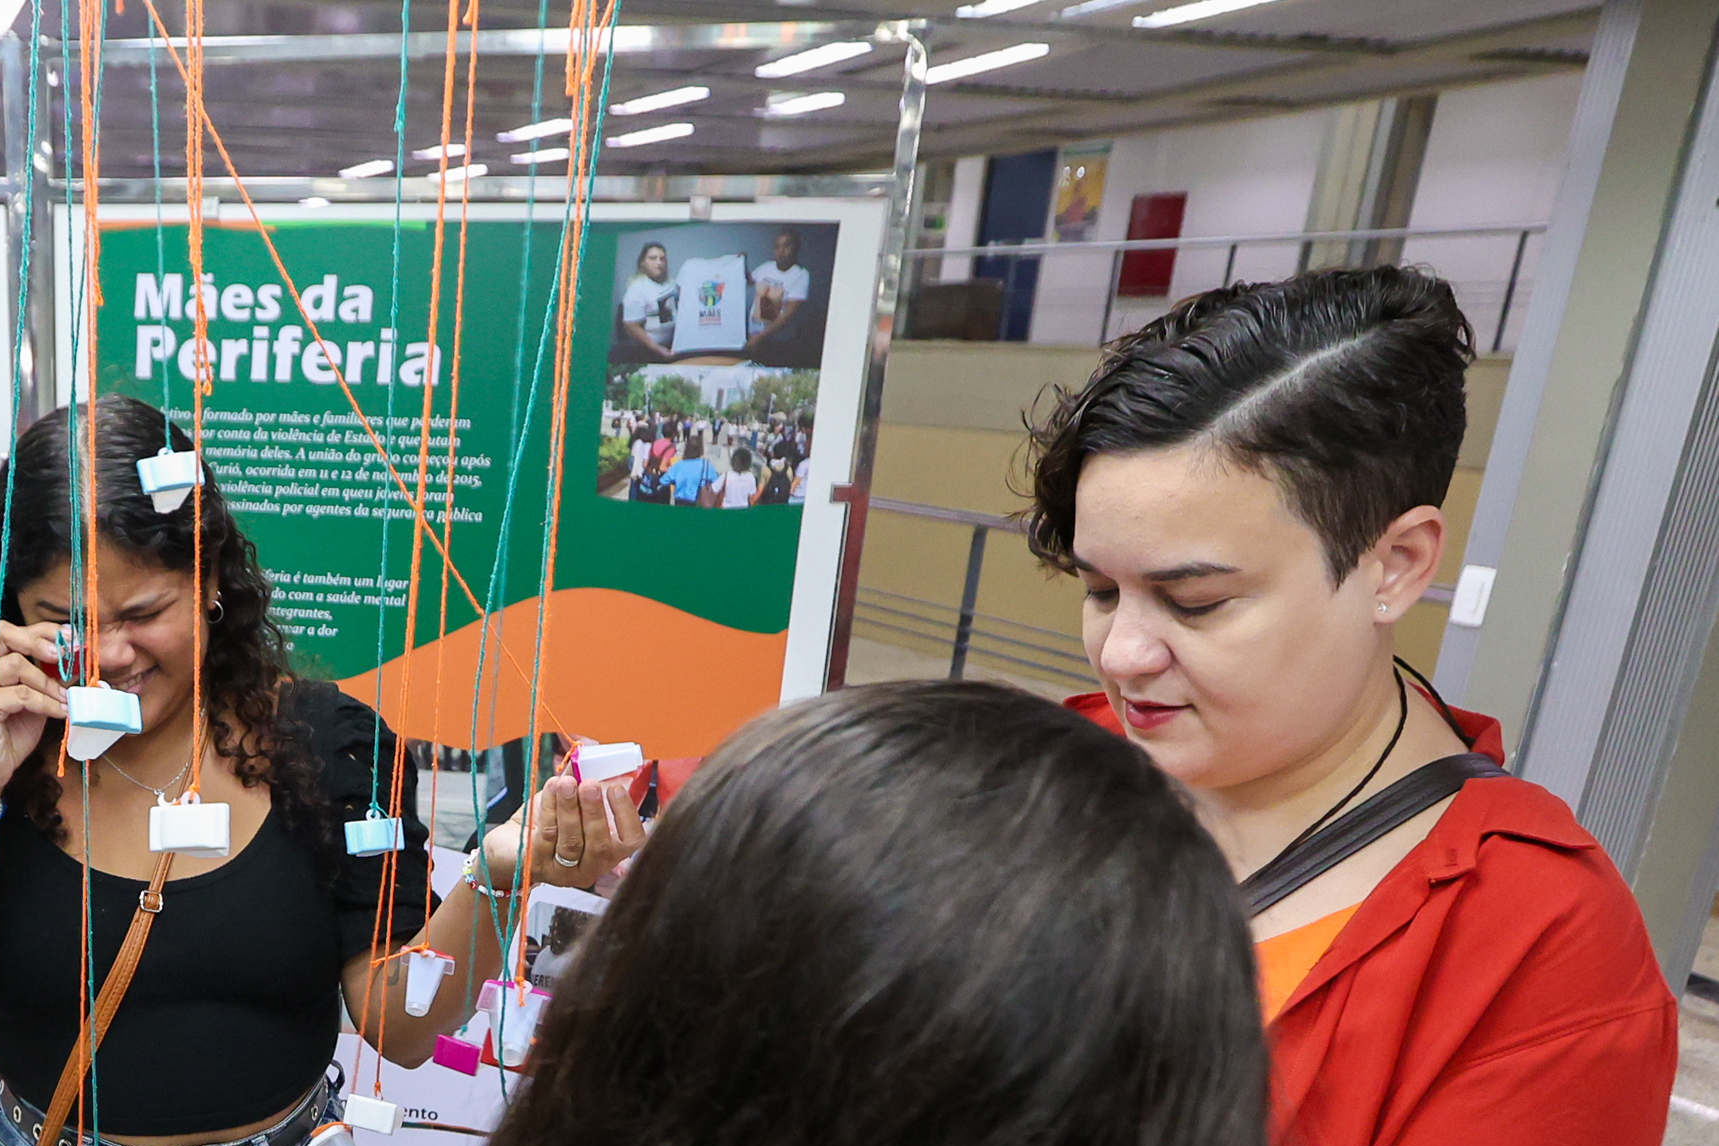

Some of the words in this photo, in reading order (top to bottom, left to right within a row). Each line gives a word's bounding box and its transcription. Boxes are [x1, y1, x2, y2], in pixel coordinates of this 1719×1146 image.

[134, 272, 282, 321] Mães
[300, 274, 375, 323] da
[134, 325, 442, 386] Periferia
[202, 407, 254, 424] formado
[255, 412, 277, 424] por
[279, 411, 310, 424] mães
[313, 413, 322, 424] e
[217, 429, 252, 440] conta
[253, 427, 269, 440] da
[271, 428, 324, 441] violência
[327, 430, 342, 443] de
[398, 435, 421, 448] que
[206, 445, 261, 458] memória
[263, 446, 293, 459] deles.
[295, 447, 306, 459] A
[308, 448, 343, 460] união
[345, 449, 361, 462] do
[461, 453, 491, 470] após
[245, 464, 295, 477] ocorrida
[298, 467, 316, 478] em
[331, 469, 339, 479] e
[354, 466, 370, 480] de
[220, 480, 272, 494] violência
[274, 482, 319, 498] policial
[321, 486, 340, 497] em
[282, 503, 304, 517] por
[305, 504, 351, 519] agentes
[354, 504, 369, 517] da
[293, 571, 301, 584] é
[303, 572, 351, 587] também
[353, 576, 374, 588] um
[288, 590, 313, 601] com
[316, 592, 324, 602] a
[326, 591, 361, 604] saúde
[307, 627, 315, 636] a
[317, 623, 339, 637] dor
